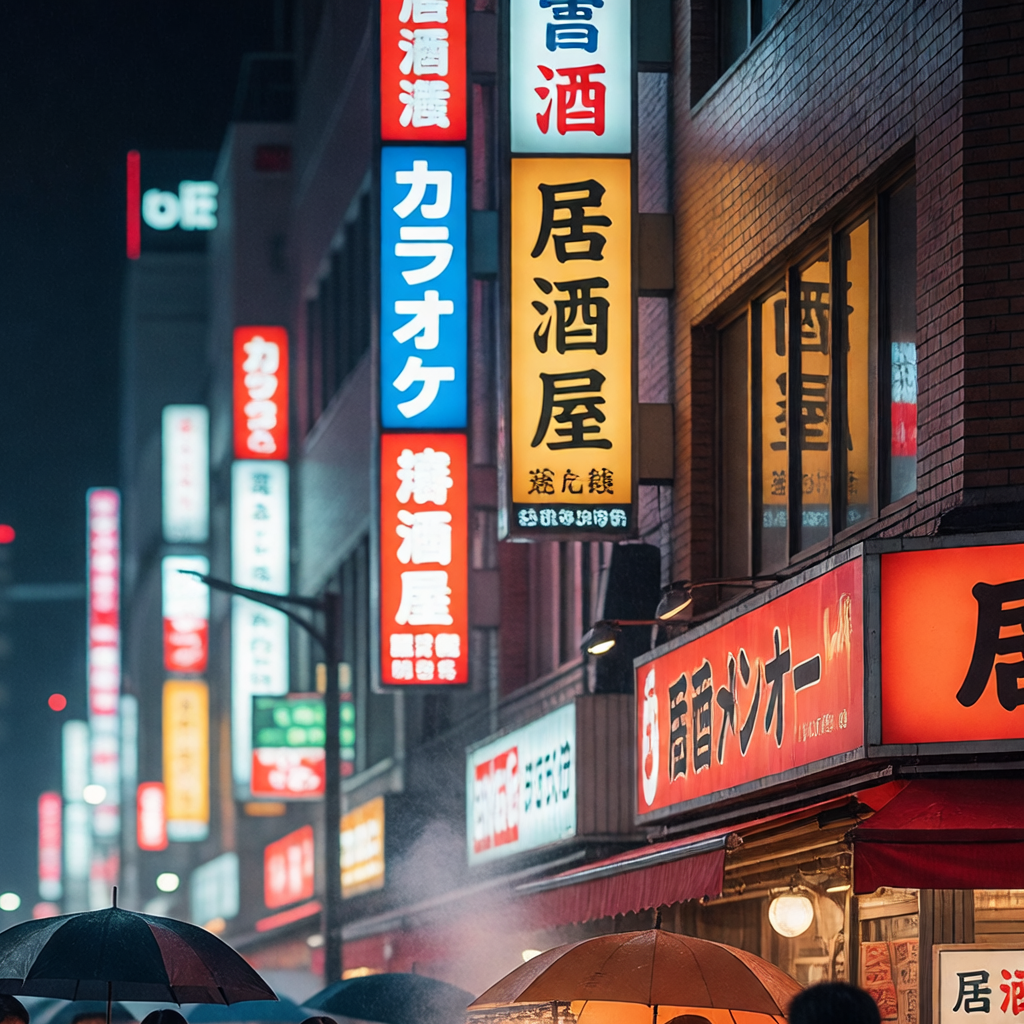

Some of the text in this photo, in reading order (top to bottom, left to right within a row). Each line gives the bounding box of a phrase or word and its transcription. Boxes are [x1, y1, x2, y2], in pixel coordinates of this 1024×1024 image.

[392, 160, 455, 420] カラオケ
[531, 179, 613, 452] 居酒屋
